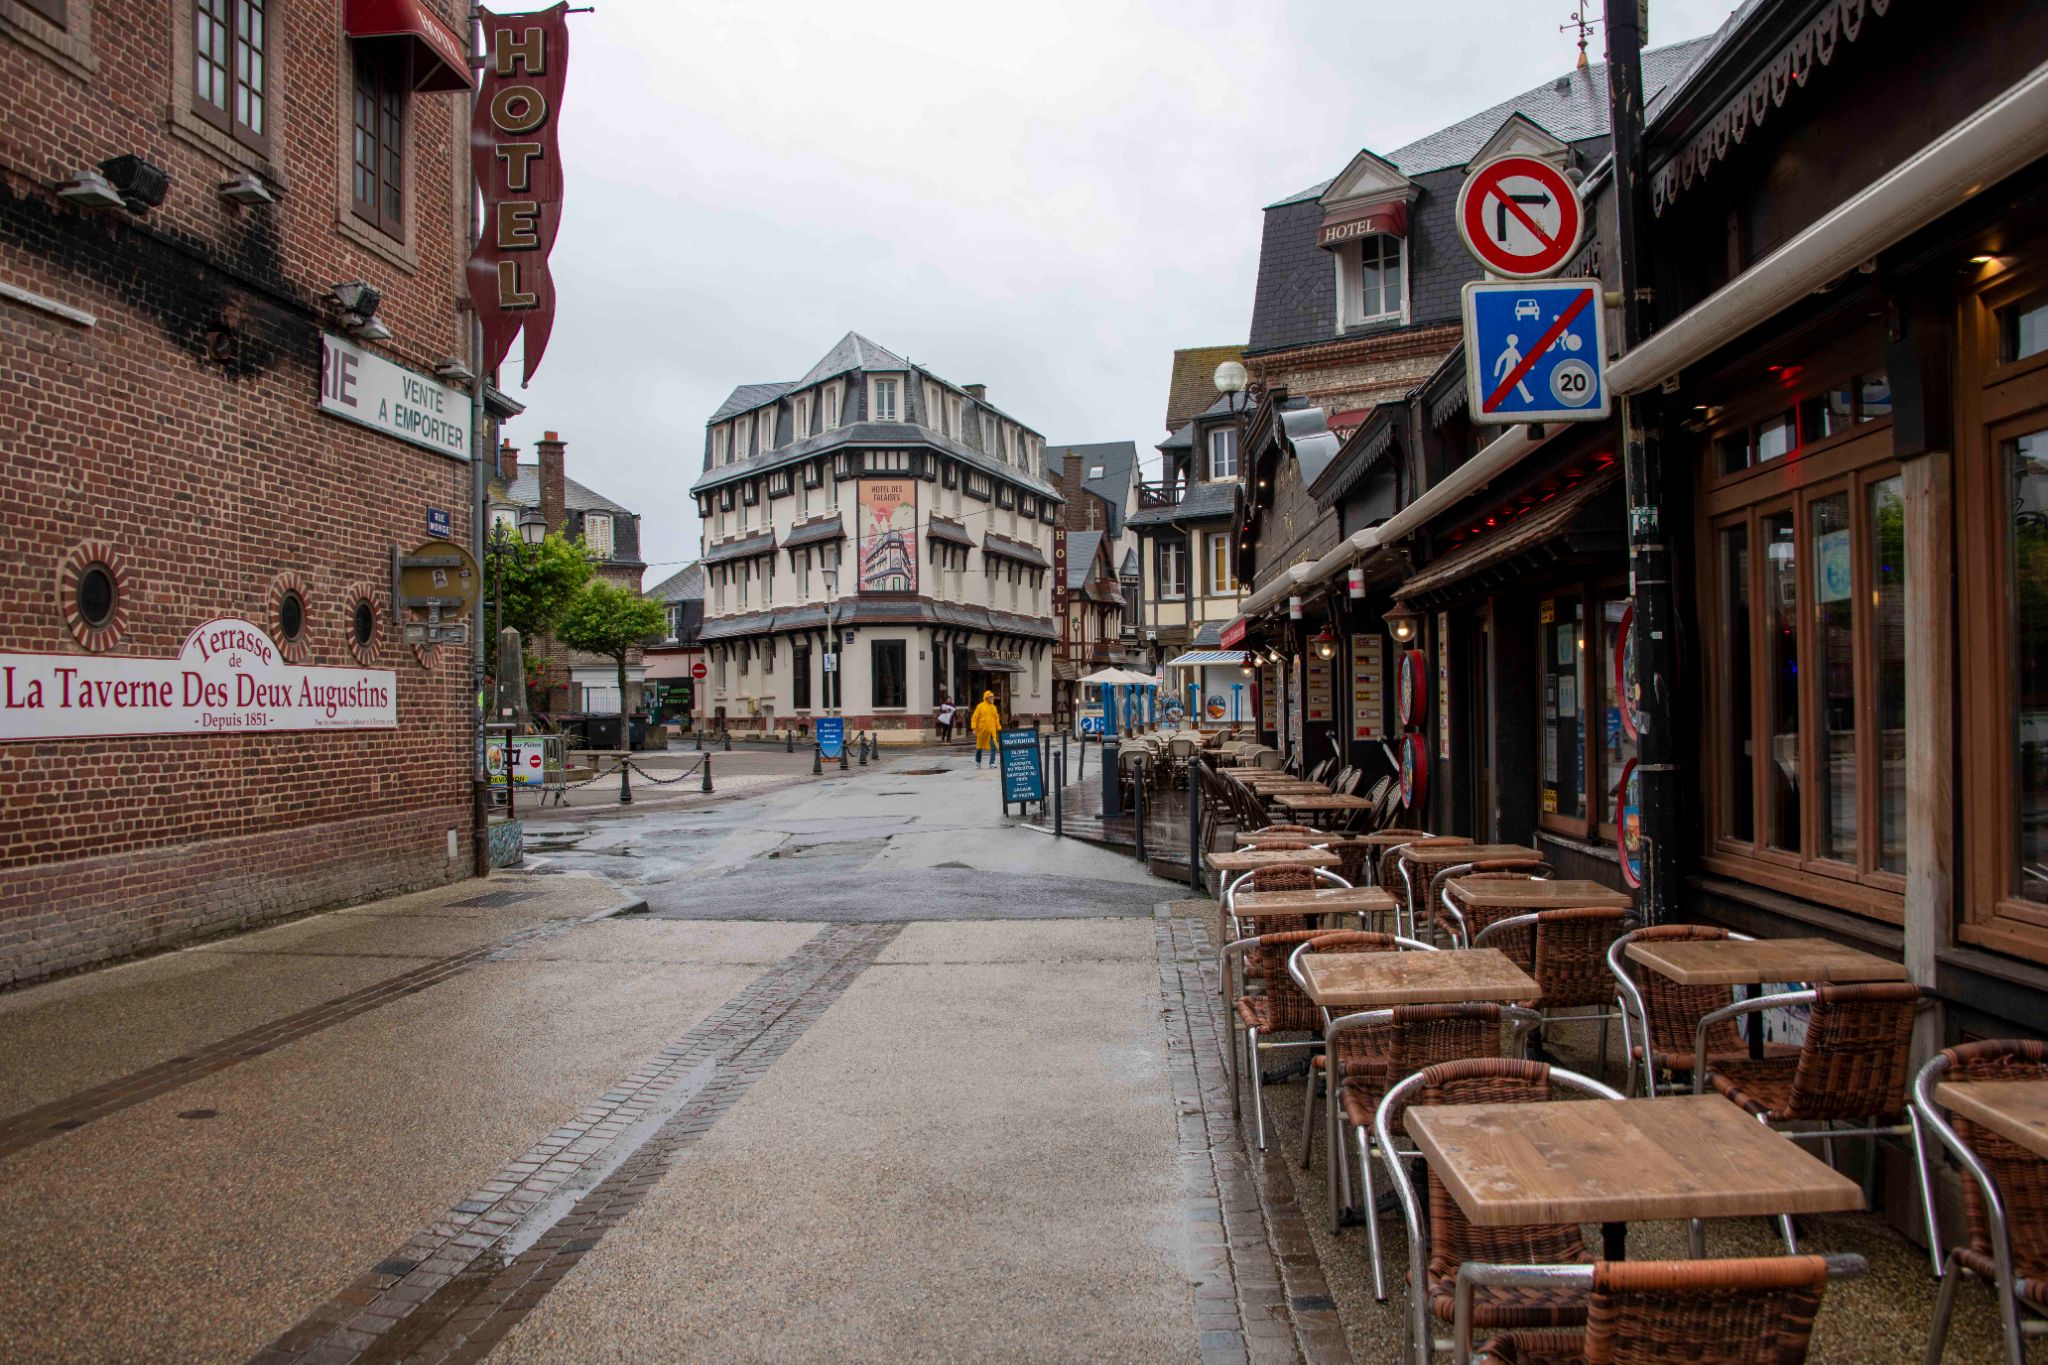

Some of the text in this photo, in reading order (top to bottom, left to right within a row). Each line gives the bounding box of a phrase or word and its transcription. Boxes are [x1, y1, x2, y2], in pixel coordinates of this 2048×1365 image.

[490, 27, 546, 310] HOTEL
[1325, 219, 1376, 241] HOTEL
[1560, 373, 1586, 392] 20
[402, 375, 444, 414] VENTE
[378, 397, 464, 450] A EMPORTER
[871, 485, 903, 493] HOTEL DES
[873, 493, 901, 502] FALAISES
[434, 512, 445, 523] RUE
[430, 523, 450, 535] MONGE
[1055, 530, 1065, 613] HOTEL
[192, 628, 272, 667] Terrasse
[228, 652, 242, 668] de
[3, 666, 388, 718] La Taverne Des Deux Augustins
[202, 712, 242, 730] Depuis
[244, 713, 267, 727] 1851
